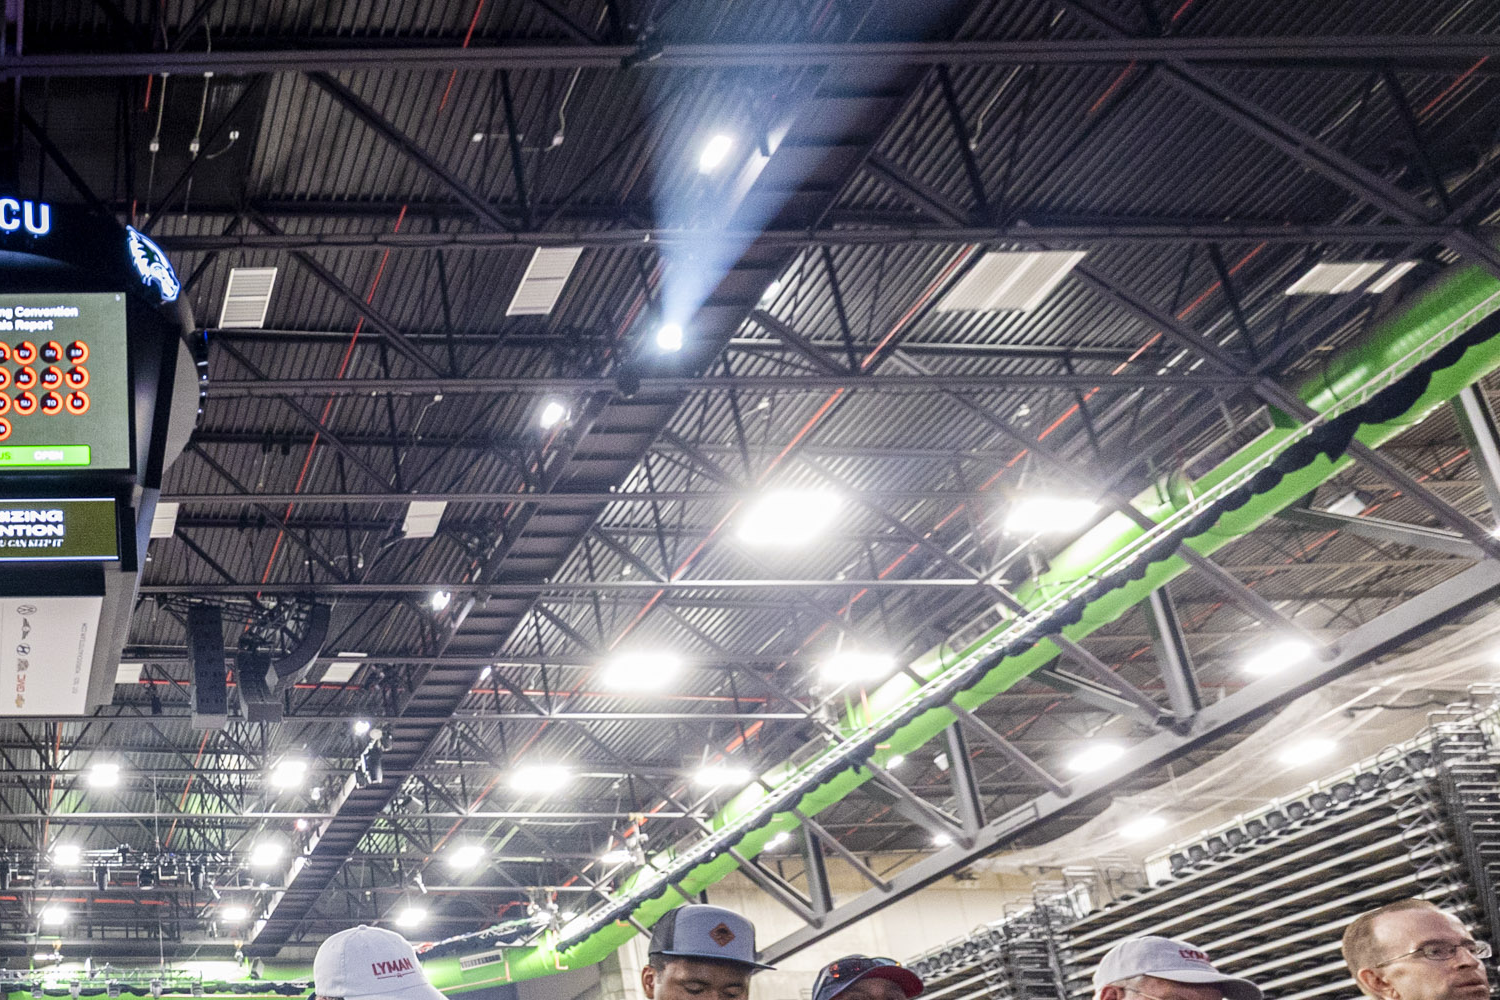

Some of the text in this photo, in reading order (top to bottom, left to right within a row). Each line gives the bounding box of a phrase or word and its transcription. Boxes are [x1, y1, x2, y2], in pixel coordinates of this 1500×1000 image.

[15, 306, 78, 317] Convention
[15, 319, 53, 332] Report
[8, 539, 27, 547] CAN
[28, 539, 50, 547] KEEP
[51, 538, 64, 547] IT
[16, 674, 26, 693] GMC
[371, 957, 414, 976] LYMAN
